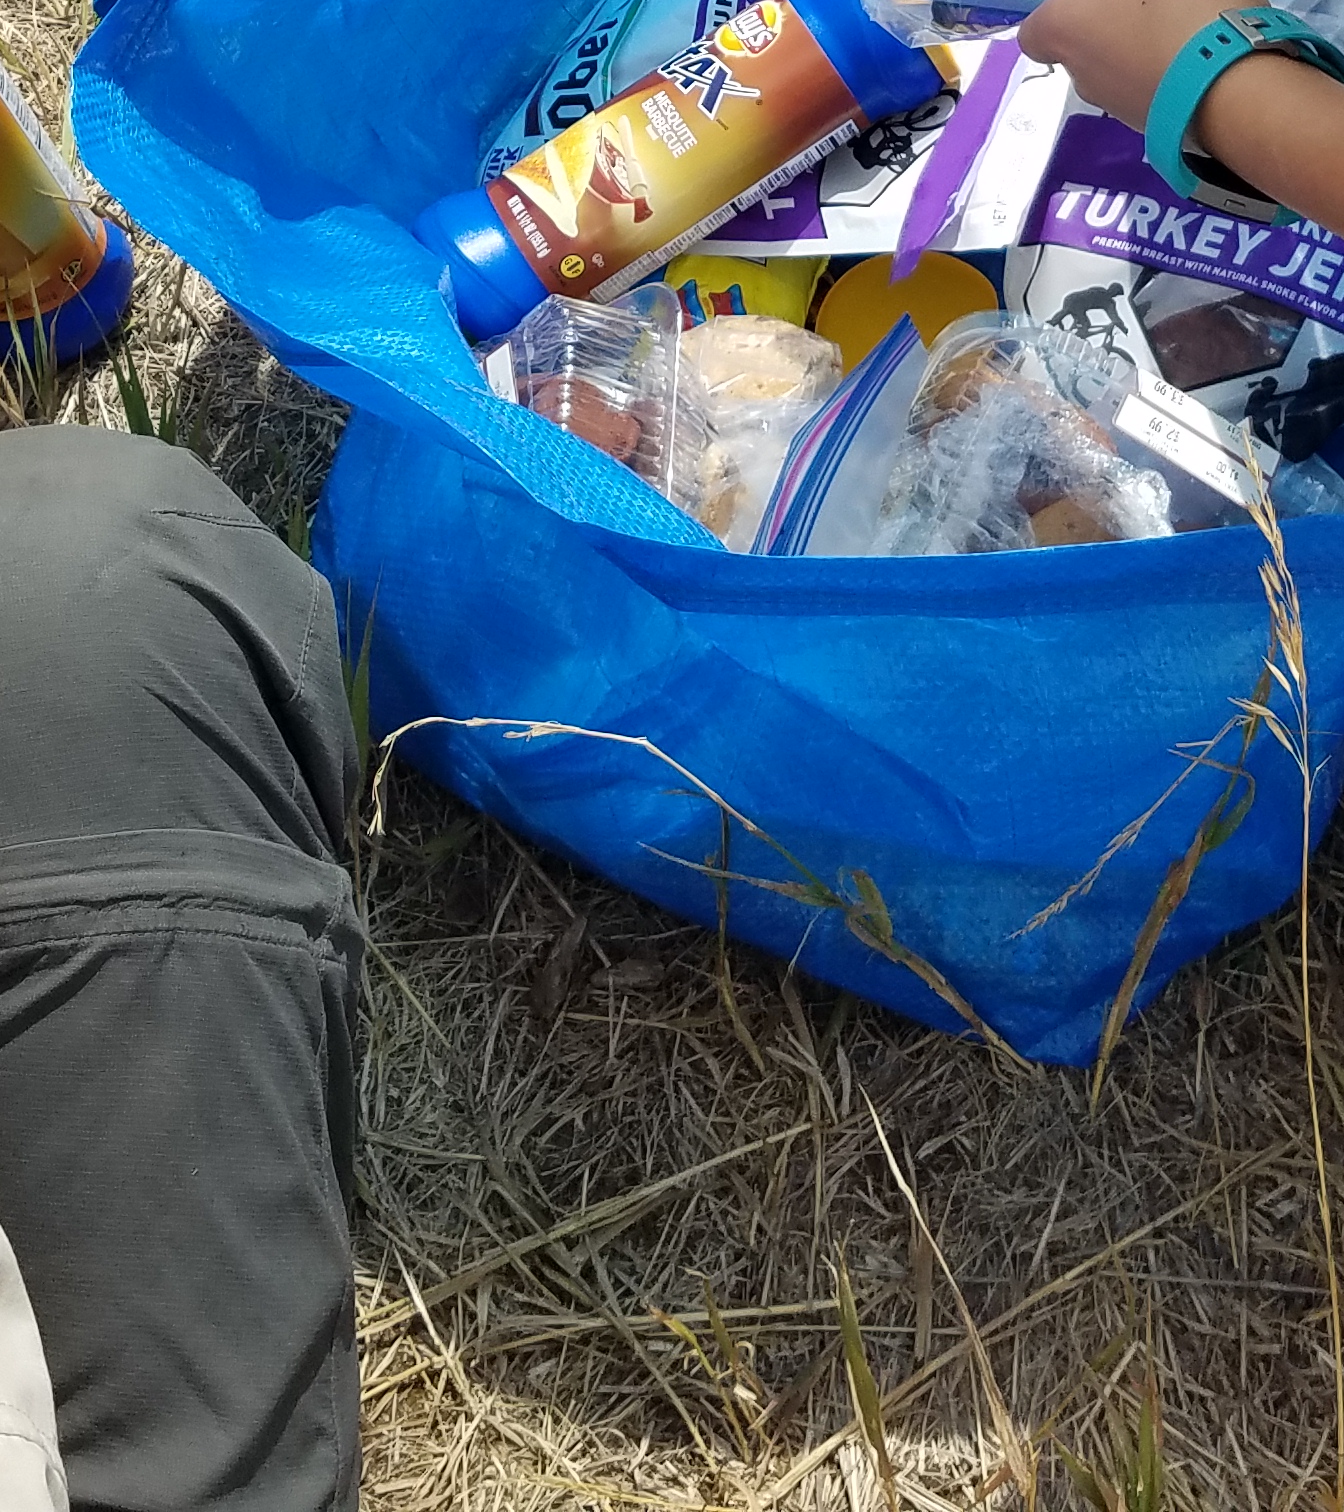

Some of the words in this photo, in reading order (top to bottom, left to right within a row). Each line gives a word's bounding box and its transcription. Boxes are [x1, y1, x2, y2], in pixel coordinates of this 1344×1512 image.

[641, 97, 686, 160] BARBECUE
[653, 90, 698, 151] MESQUITE
[1055, 180, 1272, 266] TURKEY
[1091, 235, 1142, 254] PREMIUM
[1142, 246, 1185, 268] BREAST
[1184, 259, 1213, 274] WITH
[1212, 266, 1259, 286] NATURAL
[1260, 279, 1297, 301] SMOKE
[1297, 293, 1338, 319] FLAVOR
